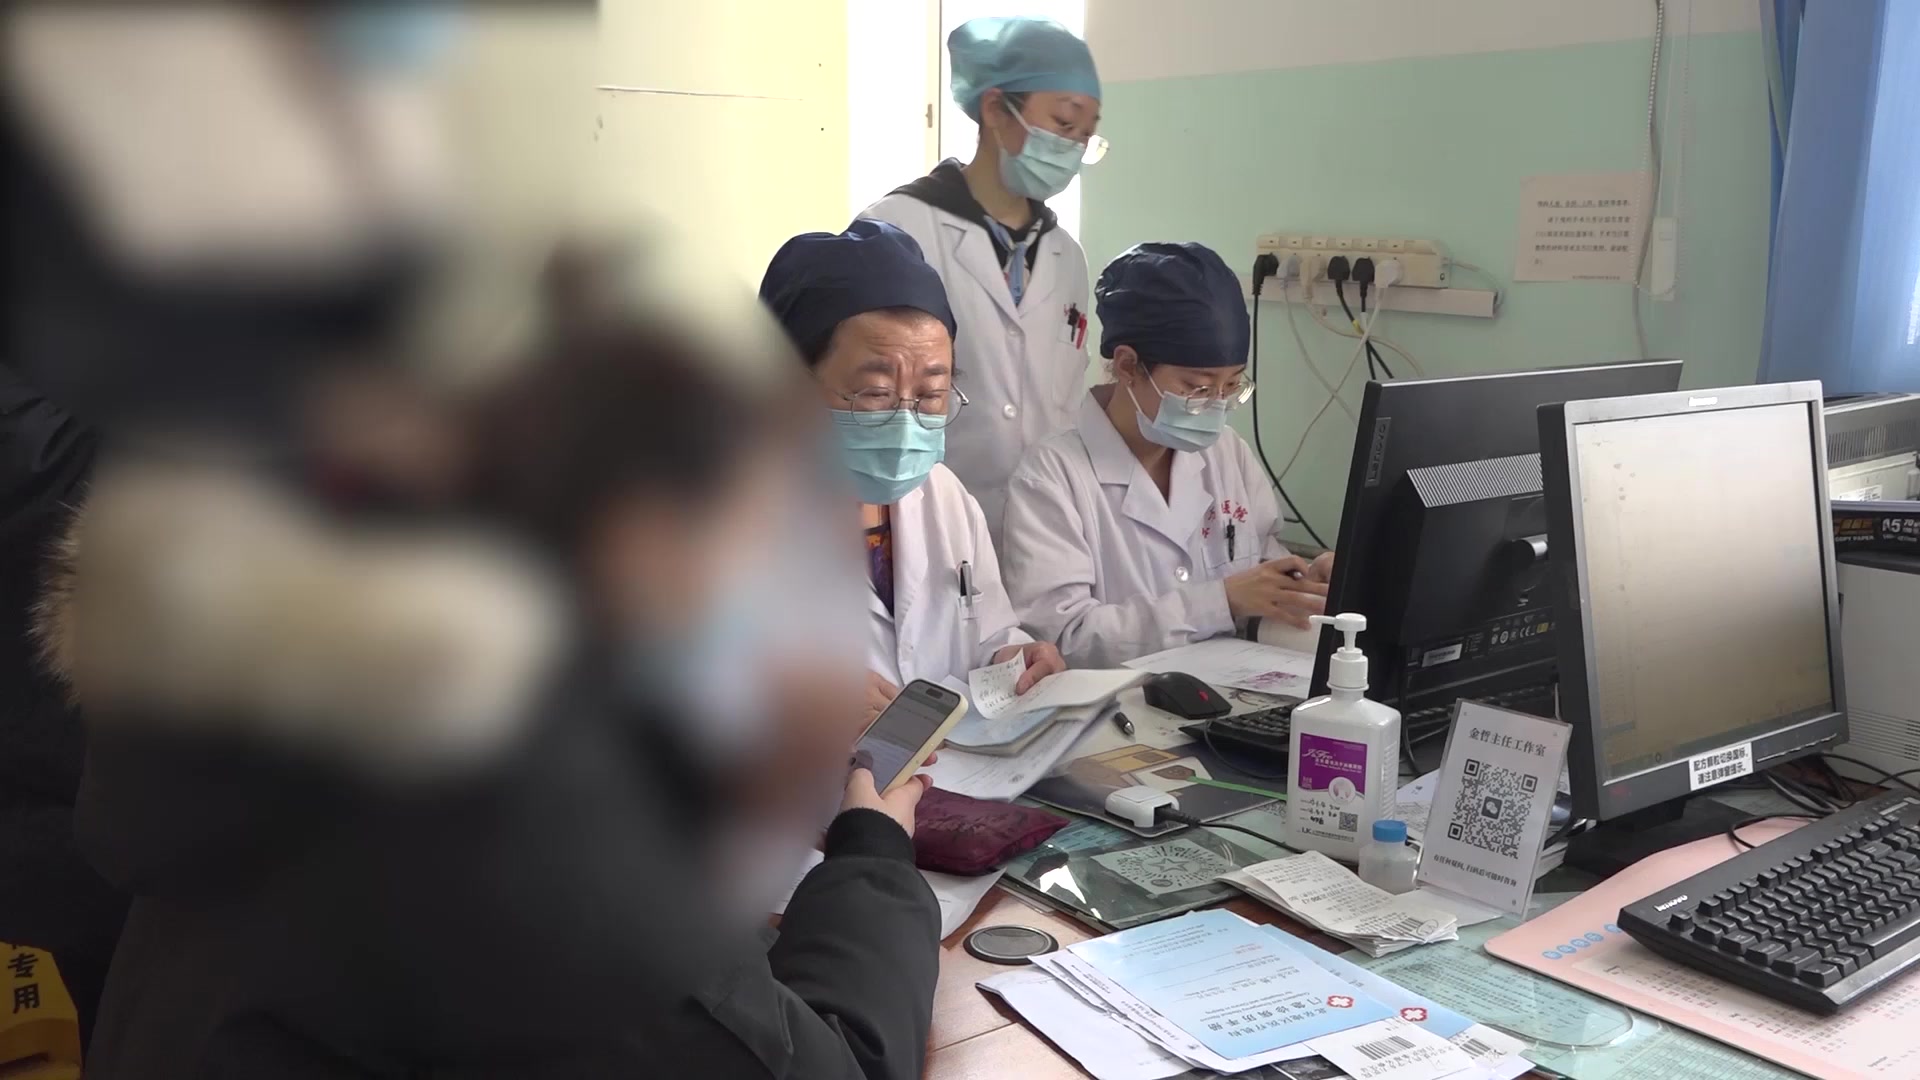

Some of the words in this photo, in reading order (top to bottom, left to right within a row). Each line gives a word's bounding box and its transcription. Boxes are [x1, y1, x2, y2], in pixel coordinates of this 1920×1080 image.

[1468, 727, 1546, 757] 金哲主任工作室
[1208, 996, 1322, 1032] 门急诊病历手册
